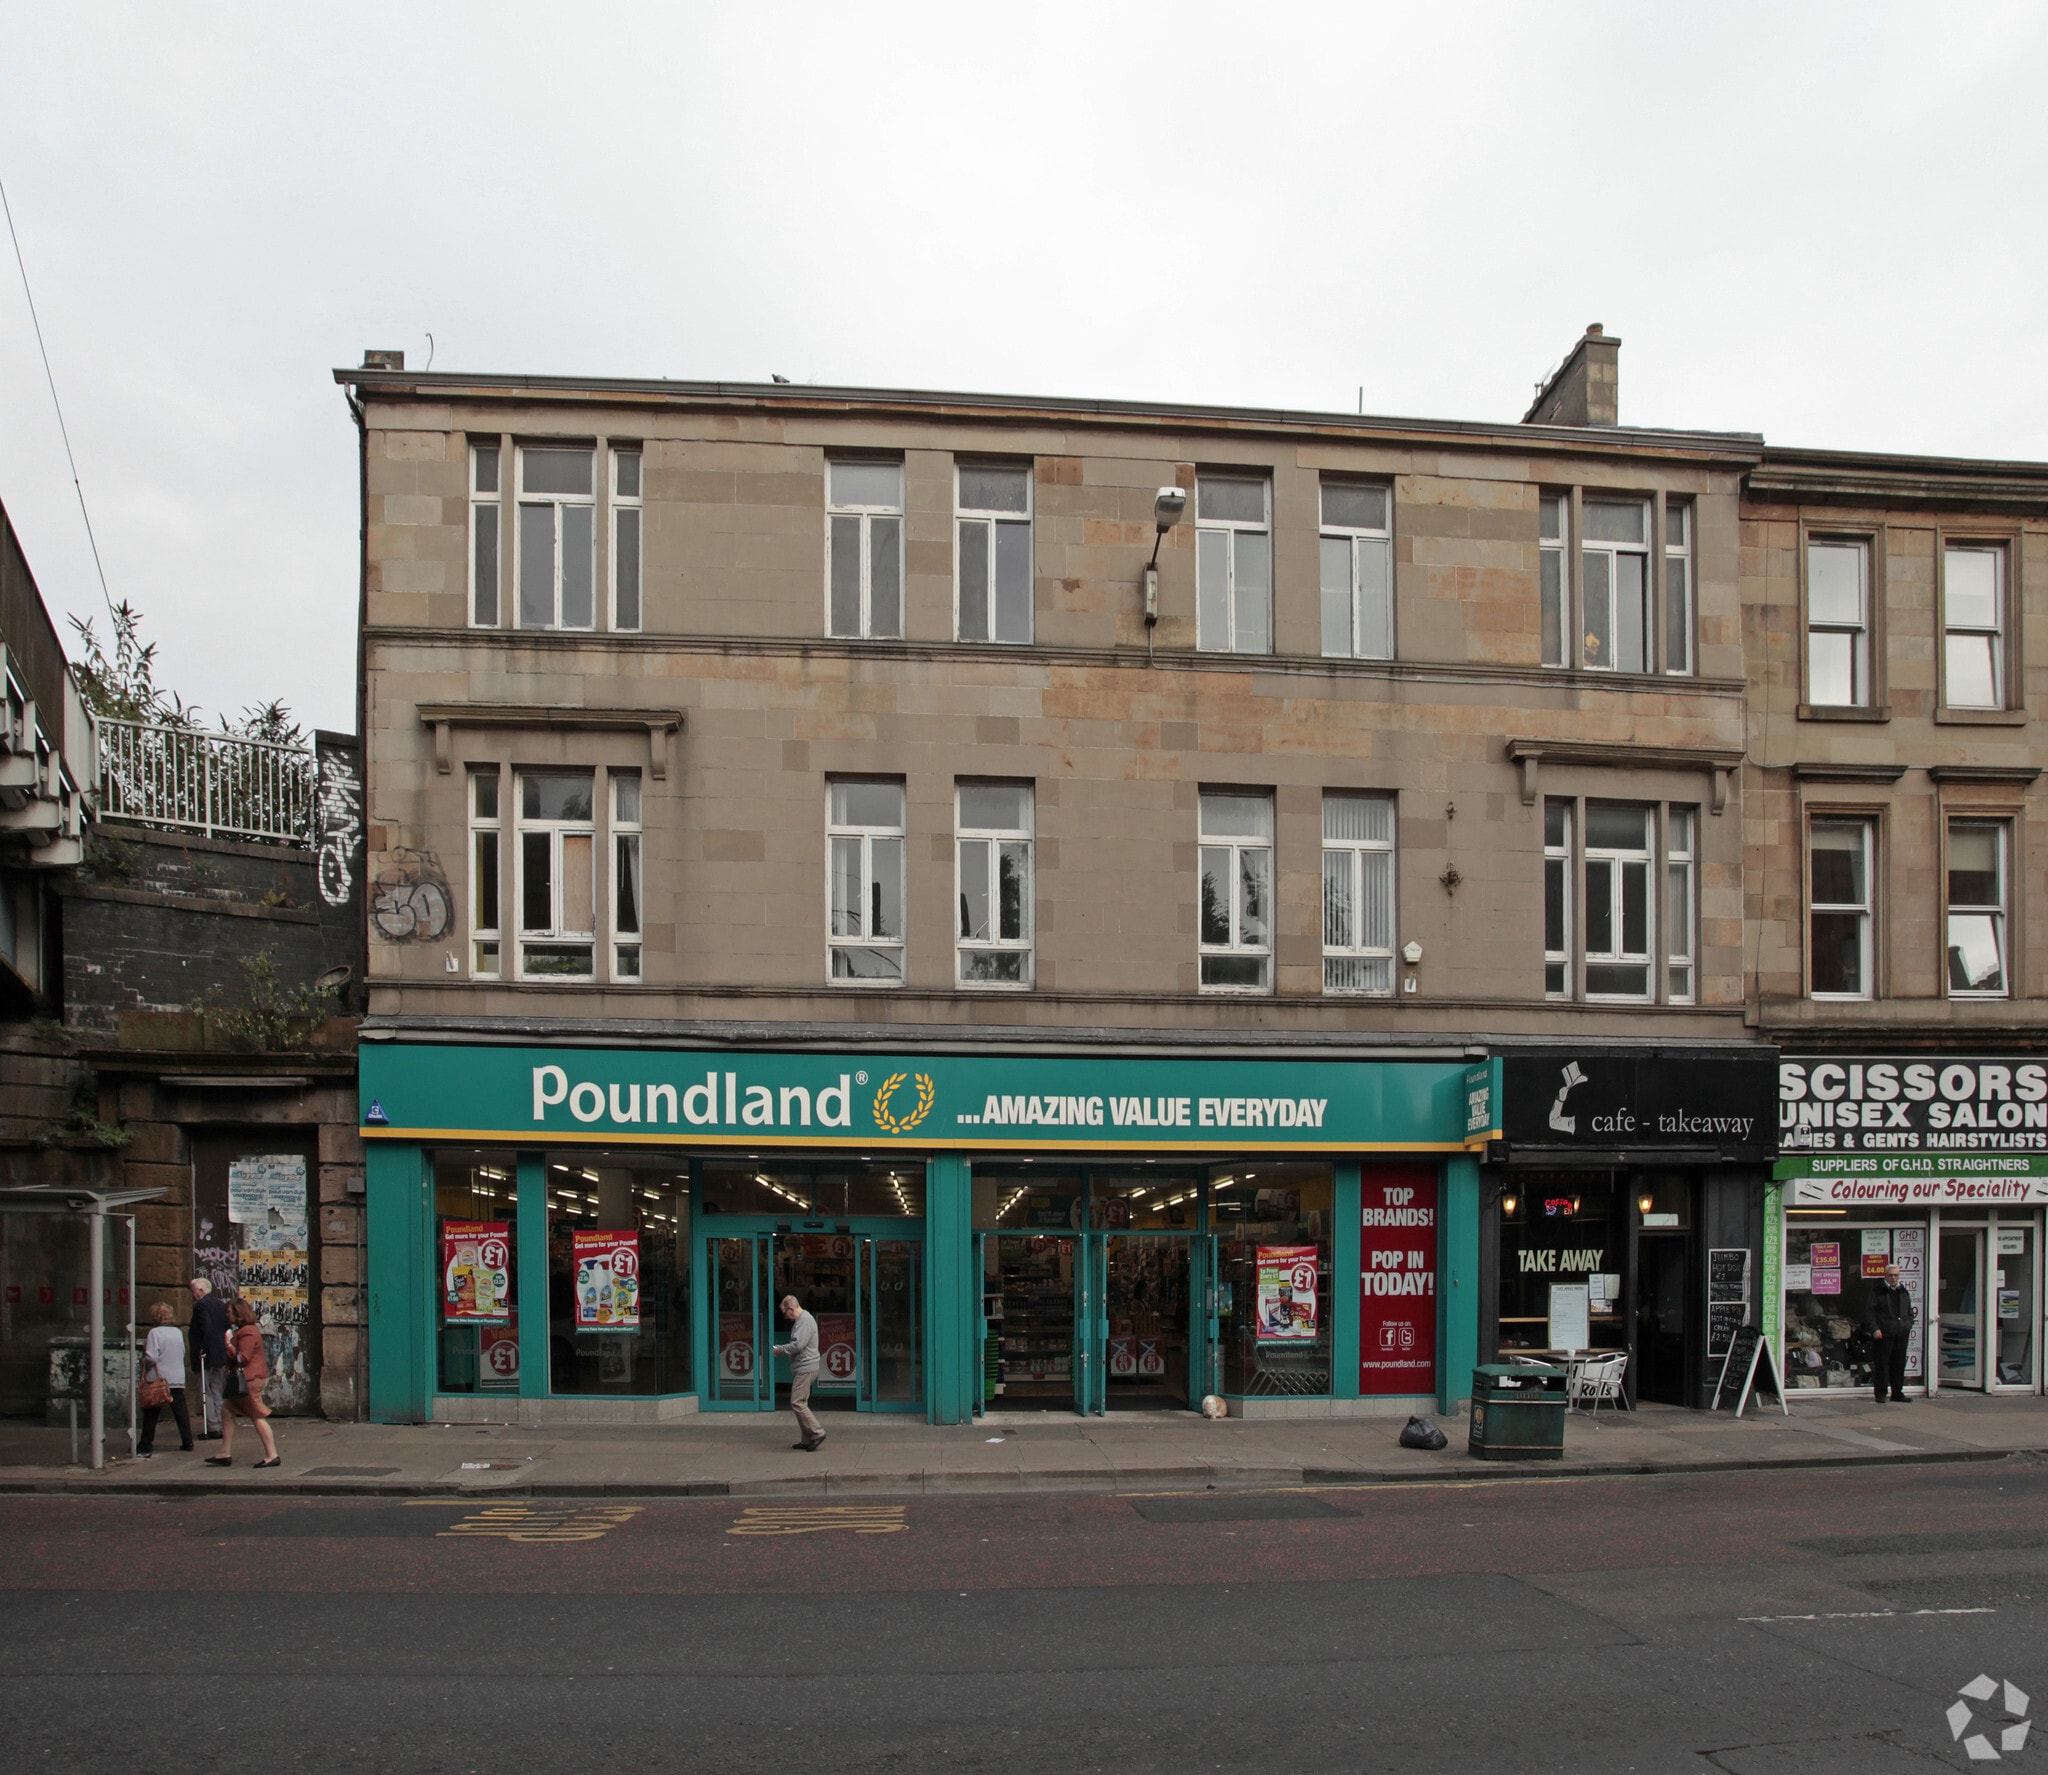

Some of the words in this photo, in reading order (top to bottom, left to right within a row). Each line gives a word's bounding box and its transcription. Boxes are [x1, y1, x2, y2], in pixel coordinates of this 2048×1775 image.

[1779, 1063, 2048, 1101] SCISSORS
[532, 1064, 851, 1128] Poundland
[1469, 1086, 1490, 1106] AMAZING
[1109, 1096, 1191, 1127] VALUE
[1198, 1097, 1328, 1128] EVERYDAY
[1471, 1100, 1486, 1118] VALUE
[1779, 1102, 1912, 1128] UNISEX
[1928, 1102, 2048, 1129] SALON
[1467, 1112, 1490, 1132] EVERYDAY
[1591, 1107, 1636, 1132] cafe
[1659, 1108, 1754, 1141] takeaway
[1843, 1133, 1855, 1148] &
[1863, 1132, 1920, 1148] GENTS
[1926, 1132, 2047, 1148] HAIRSTYLISTS
[1812, 1159, 1878, 1172] SUPPLIERS
[1883, 1159, 1899, 1171] OF
[1900, 1158, 1934, 1171] G.H.D.
[1938, 1158, 2030, 1171] STRAIGHTNERS
[1383, 1187, 1414, 1206] TOP
[1831, 1180, 1908, 1203] Colouring
[1913, 1182, 1940, 1198] our
[1945, 1179, 2031, 1201] Speciality
[1108, 1202, 1124, 1223] £1
[1362, 1208, 1434, 1227] BRANDS!
[446, 1224, 483, 1233] Poundland
[576, 1233, 612, 1242] Poundland
[1899, 1231, 1918, 1239] GHD
[484, 1245, 503, 1266] £1
[614, 1254, 633, 1274] £1
[1371, 1250, 1404, 1269] POP
[1407, 1250, 1424, 1269] IN
[1518, 1250, 1556, 1272] TAKE
[1559, 1249, 1604, 1272] AWAY
[1712, 1253, 1740, 1261] JUMBO
[1897, 1256, 1919, 1269] £79
[1294, 1269, 1312, 1288] £1
[1361, 1272, 1434, 1296] TODAY!
[494, 1347, 516, 1369] £1
[729, 1349, 750, 1370] £1
[830, 1351, 850, 1371] £1
[1363, 1360, 1431, 1370] www.poundland.com
[726, 1506, 910, 1536] BUS
